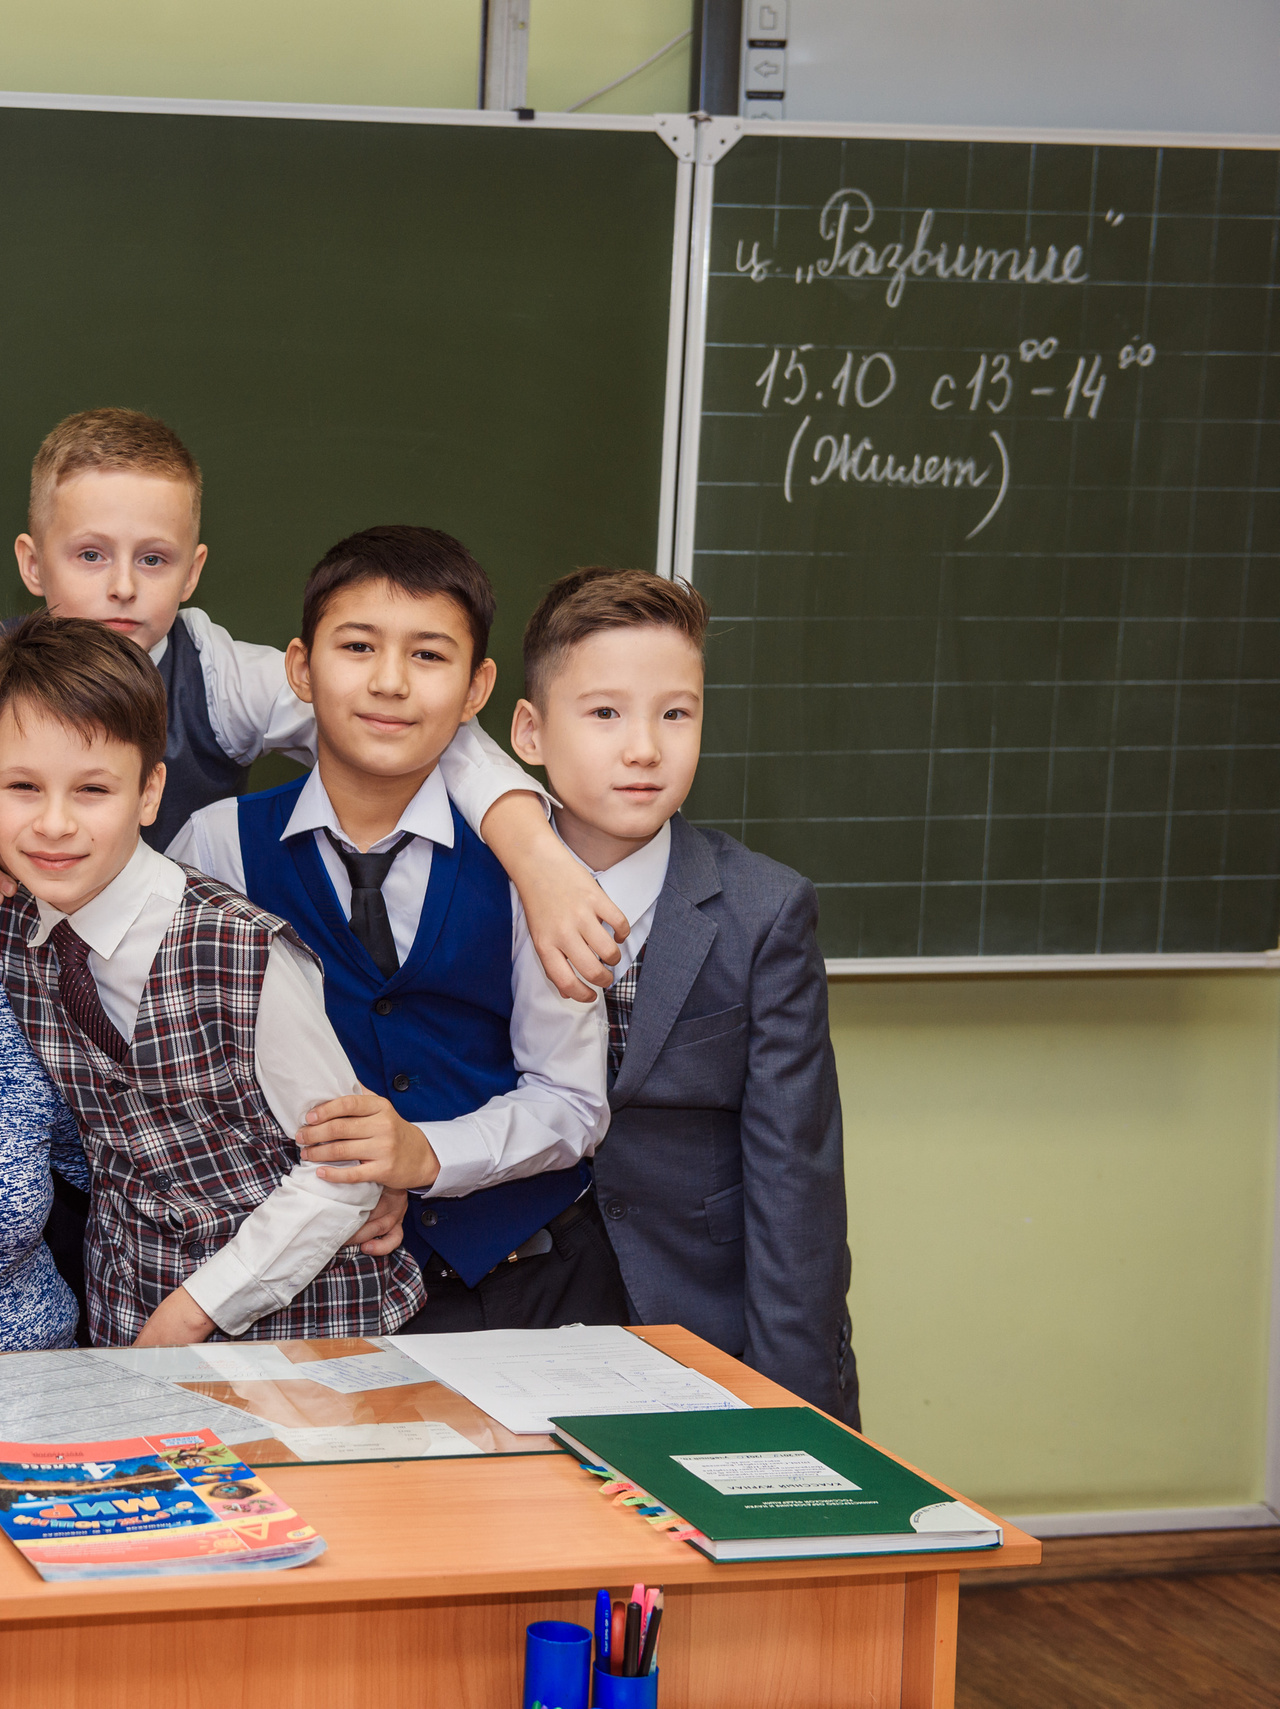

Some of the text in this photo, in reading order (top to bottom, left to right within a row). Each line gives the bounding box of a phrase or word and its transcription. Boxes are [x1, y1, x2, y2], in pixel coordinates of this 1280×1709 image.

[756, 342, 897, 409] 15.10
[80, 1462, 117, 1480] 4
[39, 1496, 161, 1519] МИР
